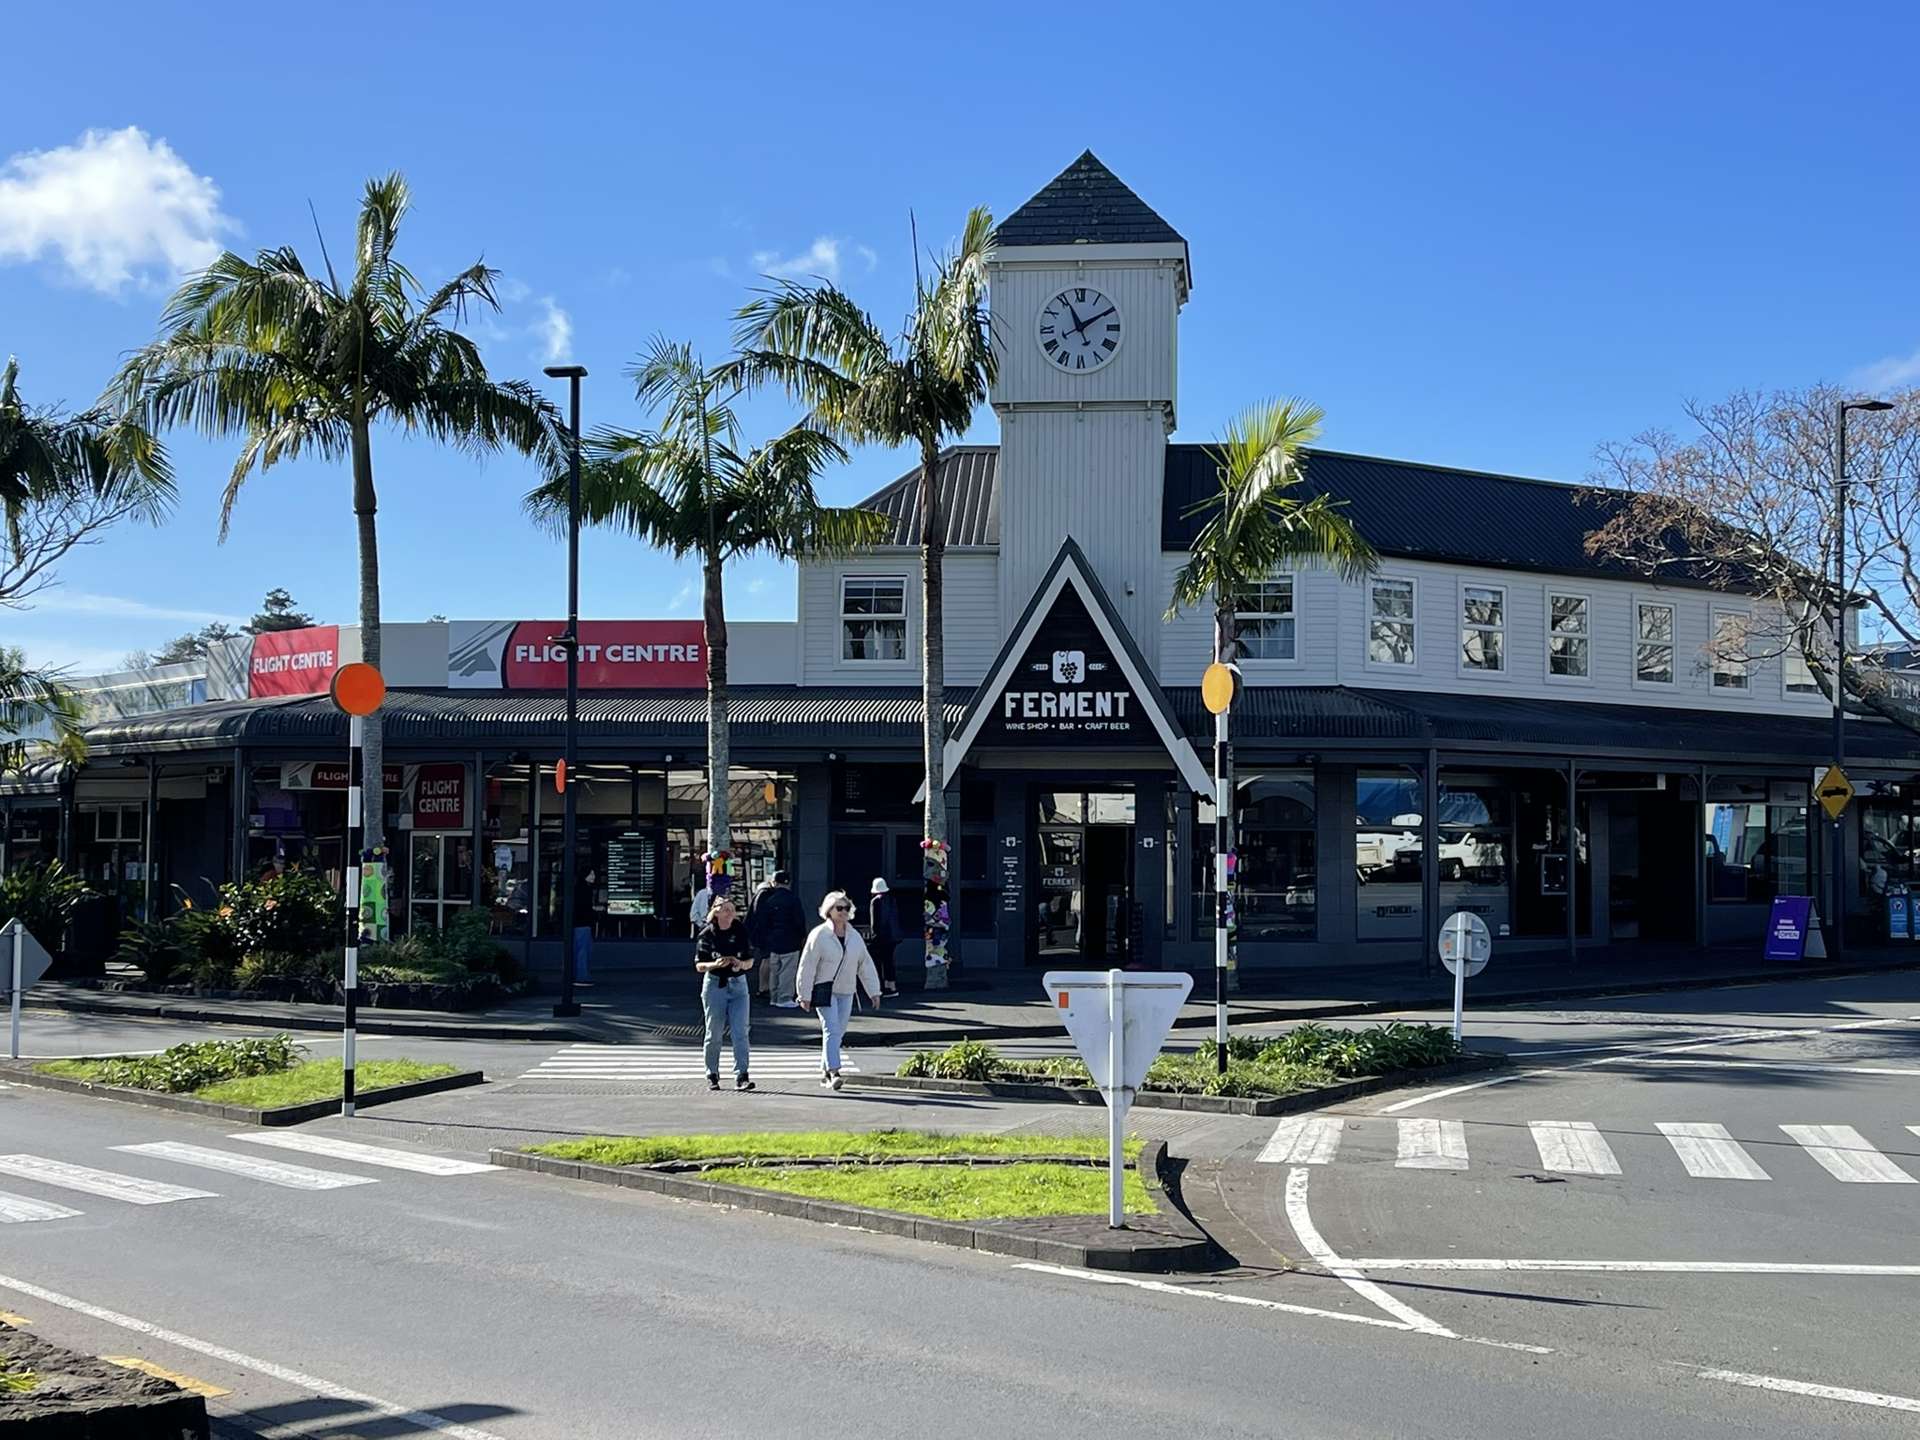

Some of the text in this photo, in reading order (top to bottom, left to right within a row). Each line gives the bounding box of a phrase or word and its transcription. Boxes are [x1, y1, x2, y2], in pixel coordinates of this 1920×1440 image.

[605, 645, 699, 662] CENTRE
[253, 650, 333, 674] FLIGHT CENTRE
[1005, 691, 1130, 718] FERMENT
[1006, 722, 1130, 731] WINE SHOP BAR CRAFT BEER
[317, 771, 349, 782] FLIGH
[421, 780, 460, 796] FLIGHT
[418, 798, 460, 813] CENTRE
